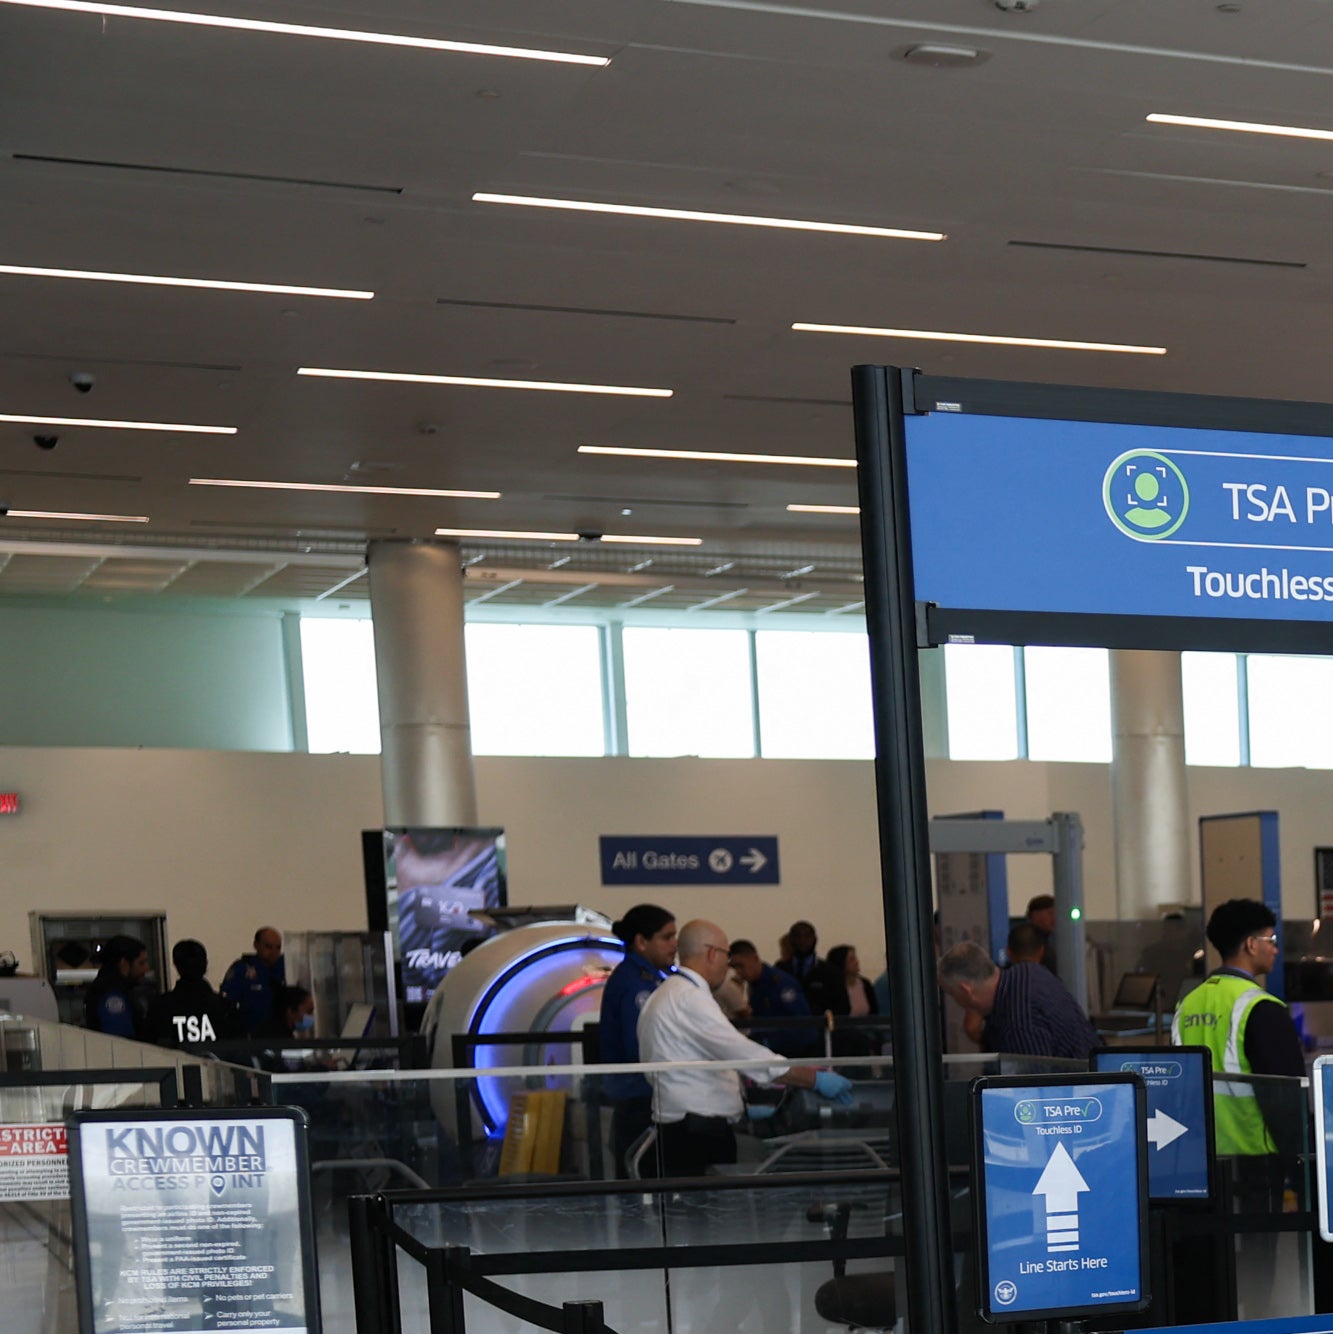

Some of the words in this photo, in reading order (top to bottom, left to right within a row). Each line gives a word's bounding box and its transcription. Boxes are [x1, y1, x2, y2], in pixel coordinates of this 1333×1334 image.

[1222, 482, 1296, 523] TSA
[613, 850, 637, 870] All
[642, 851, 699, 870] Gates
[172, 1013, 216, 1043] TSA
[1141, 1066, 1154, 1074] TSA
[1155, 1066, 1167, 1074] Pre
[1044, 1105, 1063, 1117] TSA
[1064, 1104, 1081, 1116] Pre
[1036, 1126, 1072, 1136] Touchless
[1074, 1125, 1083, 1134] ID
[11, 1141, 57, 1154] AREA
[105, 1125, 265, 1158] KNOWN
[111, 1156, 263, 1174] CREWMEMBER
[113, 1175, 190, 1191] ACCESS
[120, 1269, 140, 1277] KCM
[141, 1268, 169, 1276] RULES
[229, 1265, 274, 1273] ENFORCED
[1019, 1261, 1044, 1275] Line
[1046, 1258, 1079, 1273] Starts
[1081, 1256, 1108, 1270] Here
[141, 1275, 158, 1283] TSA
[158, 1274, 180, 1282] WITH
[144, 1282, 166, 1290] LOSS
[227, 1294, 244, 1302] pets
[252, 1293, 266, 1301] pet
[266, 1292, 294, 1300] carriers
[216, 1312, 237, 1320] Carry
[237, 1311, 253, 1319] only
[253, 1310, 271, 1319] your
[217, 1319, 249, 1328] personal
[249, 1318, 280, 1327] property
